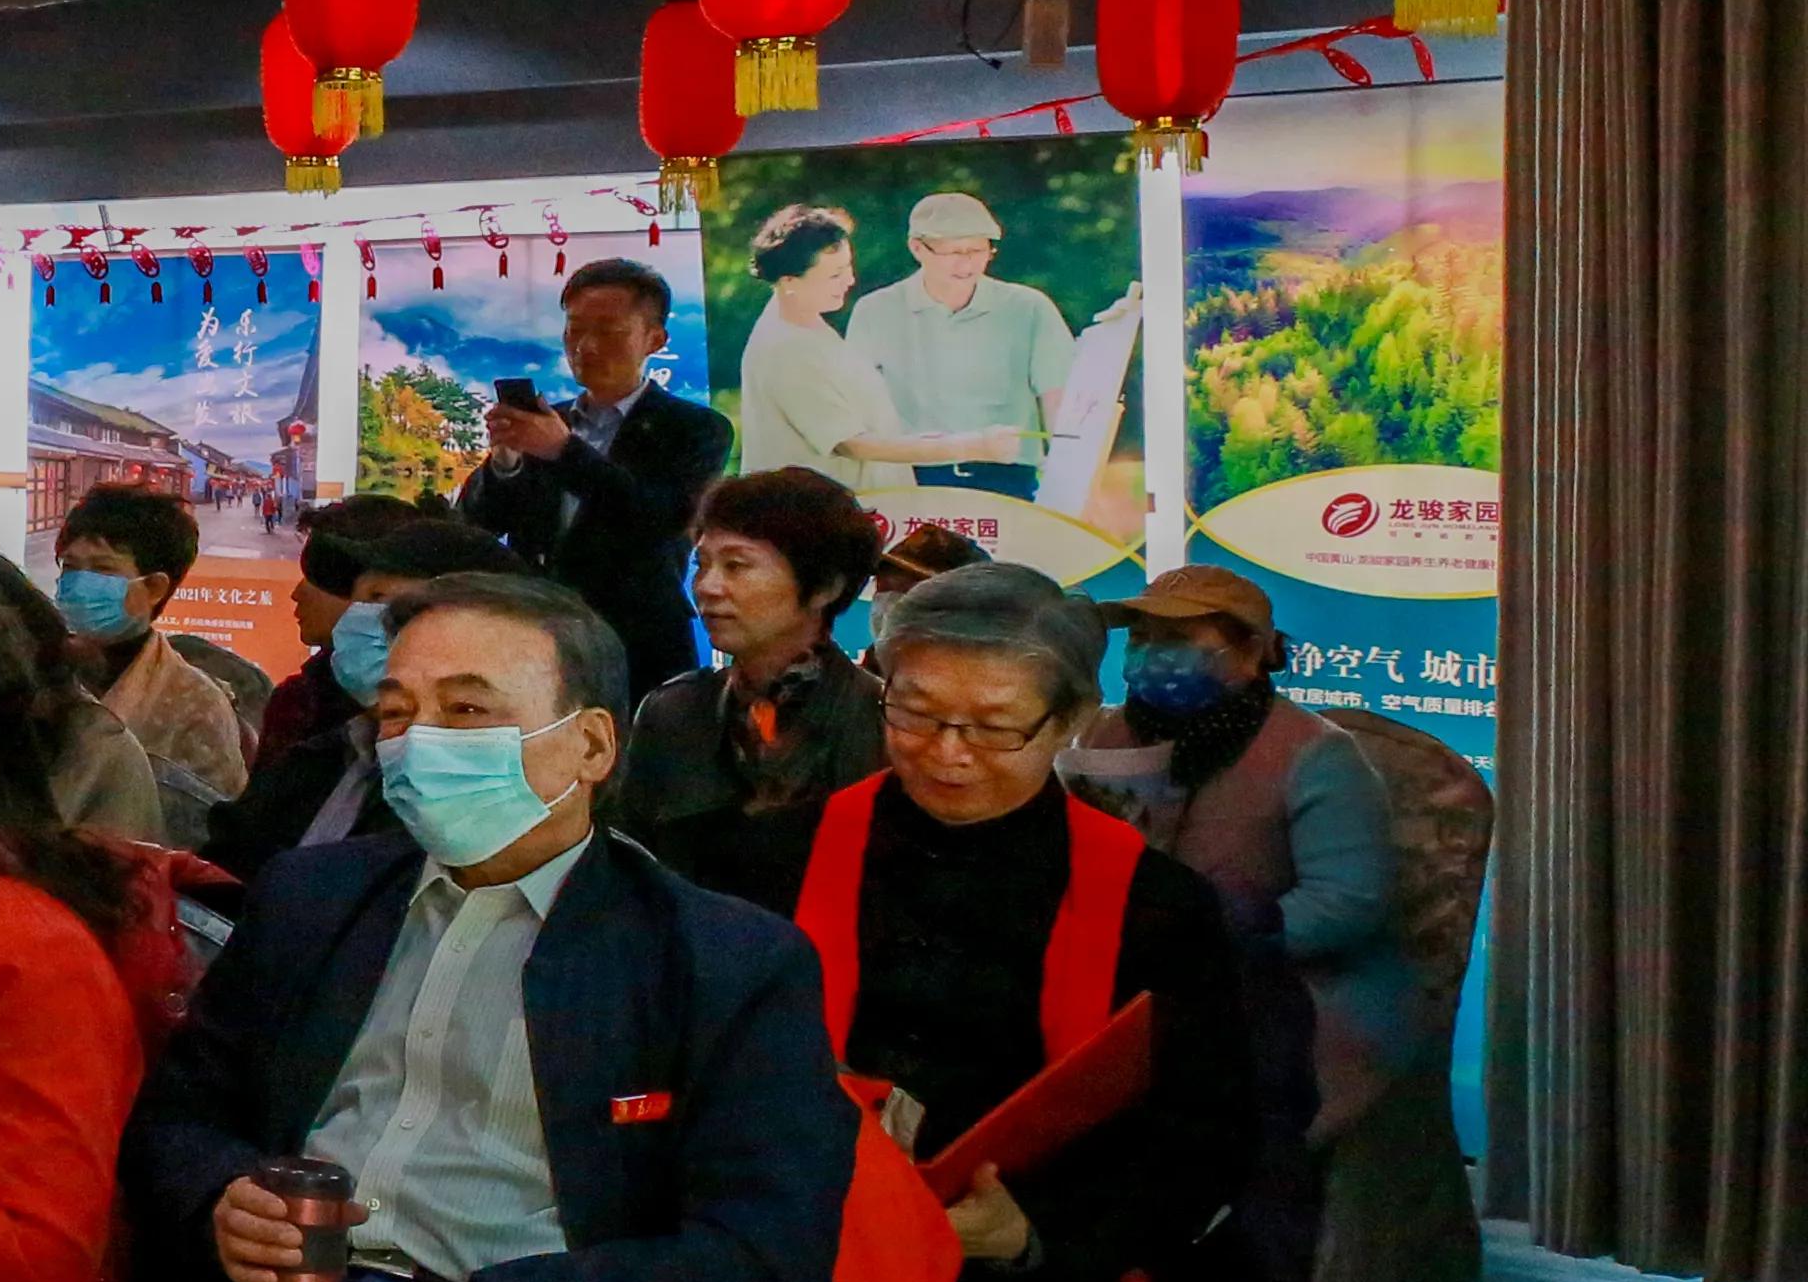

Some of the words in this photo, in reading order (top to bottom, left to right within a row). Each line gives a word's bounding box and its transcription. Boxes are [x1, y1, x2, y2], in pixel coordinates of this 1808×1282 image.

[1388, 499, 1500, 523] 龙骏家园
[1291, 640, 1405, 684] 净空气
[1420, 649, 1497, 689] 城市
